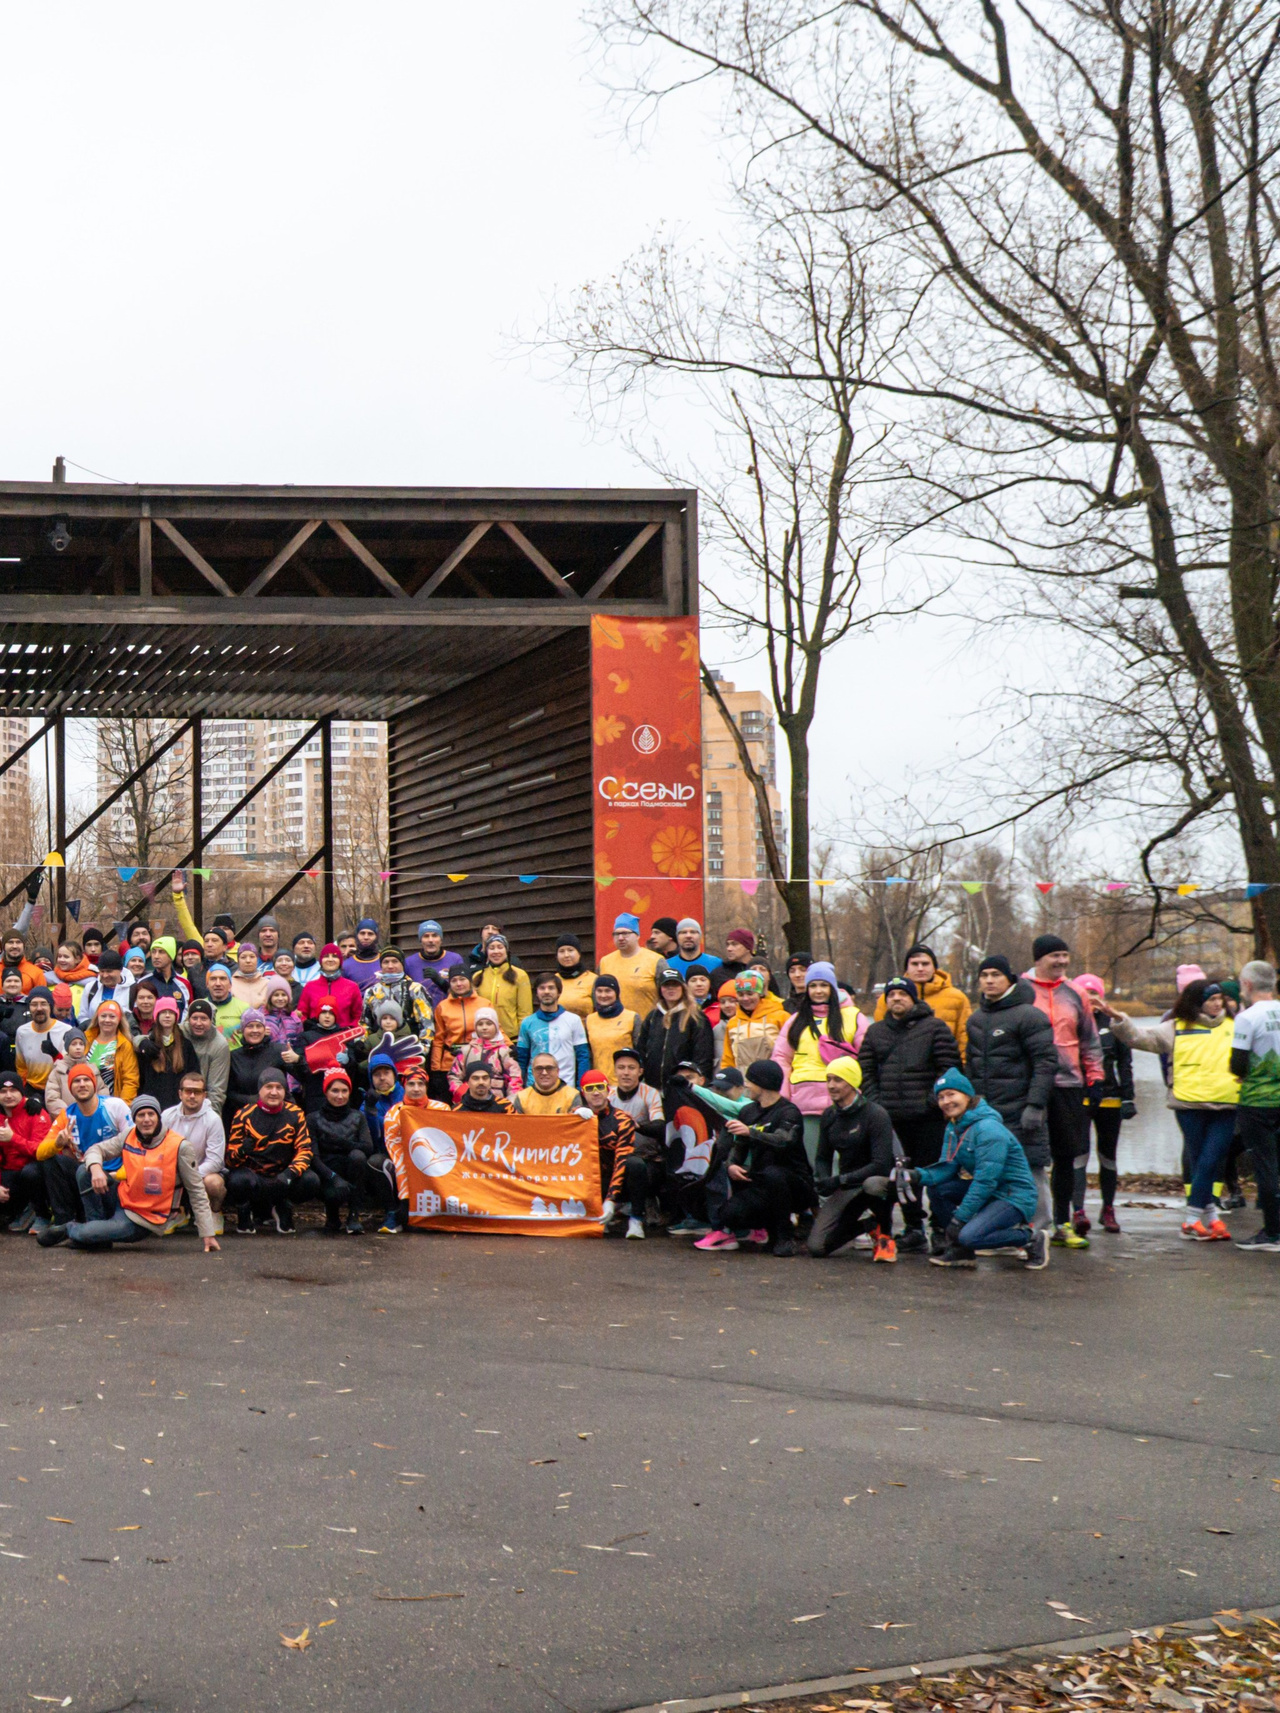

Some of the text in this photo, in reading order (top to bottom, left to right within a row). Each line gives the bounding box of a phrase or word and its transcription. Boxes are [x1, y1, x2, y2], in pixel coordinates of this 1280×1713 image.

[598, 776, 695, 800] Осень
[640, 800, 687, 808] Подмосковья
[462, 1171, 584, 1183] Железнодорожный
